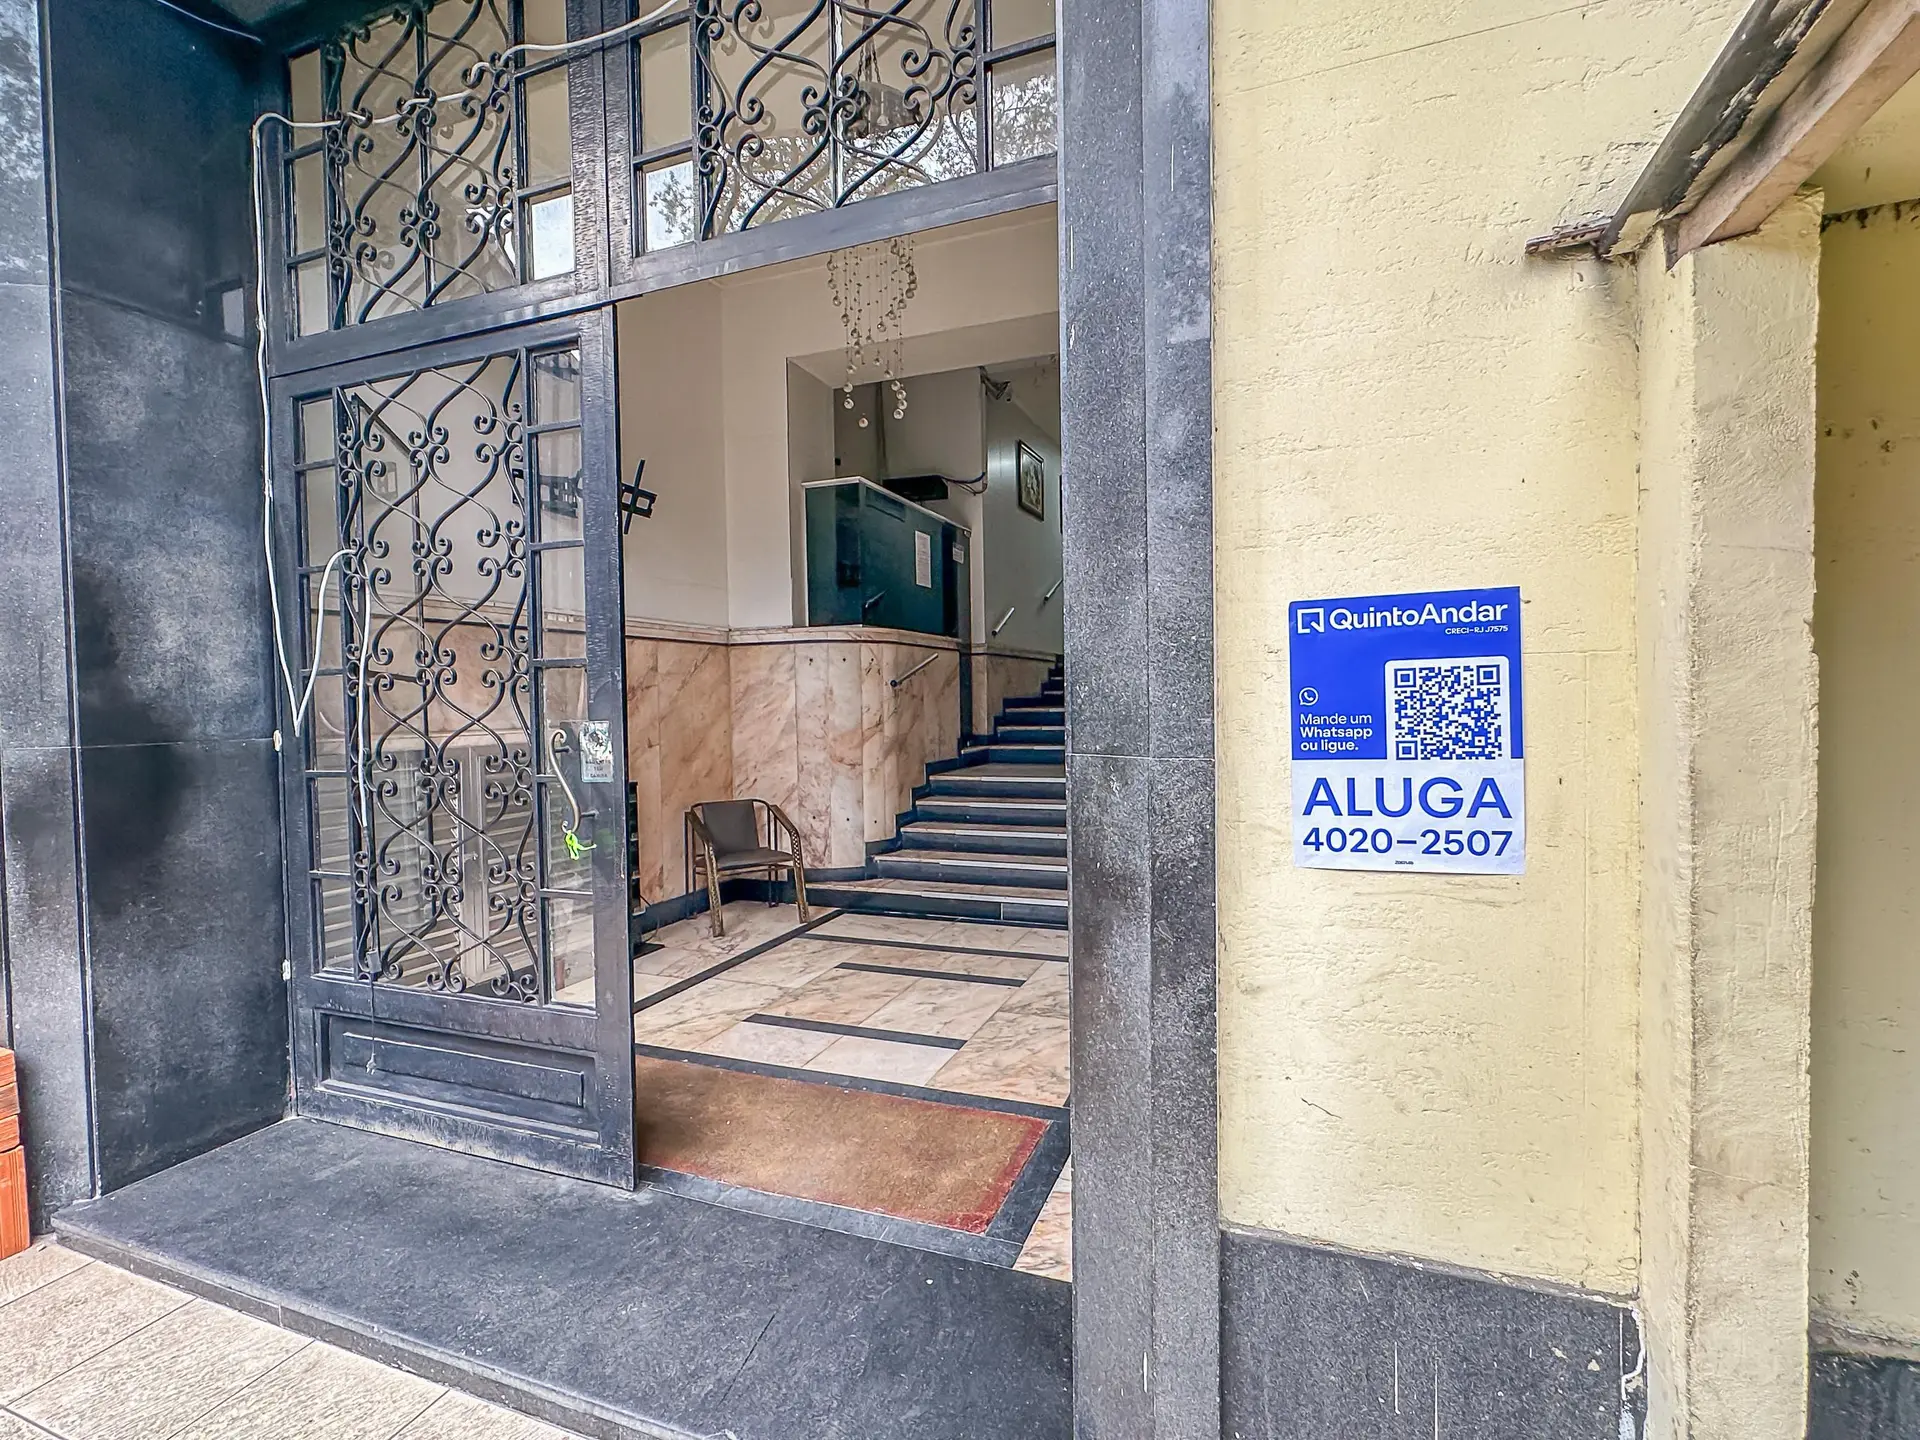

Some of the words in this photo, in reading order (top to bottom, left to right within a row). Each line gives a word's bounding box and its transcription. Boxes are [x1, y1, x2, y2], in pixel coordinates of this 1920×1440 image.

[1329, 600, 1508, 630] QuintoAndar
[1445, 626, 1484, 635] CRECI-RJ
[1300, 713, 1347, 725] Mande
[1350, 714, 1372, 724] um
[1300, 726, 1373, 739] Whatsapp
[1300, 741, 1318, 751] ou
[1321, 739, 1359, 753] ligue.
[1302, 776, 1513, 819] ALUGA
[1302, 827, 1513, 857] 4020-2507
